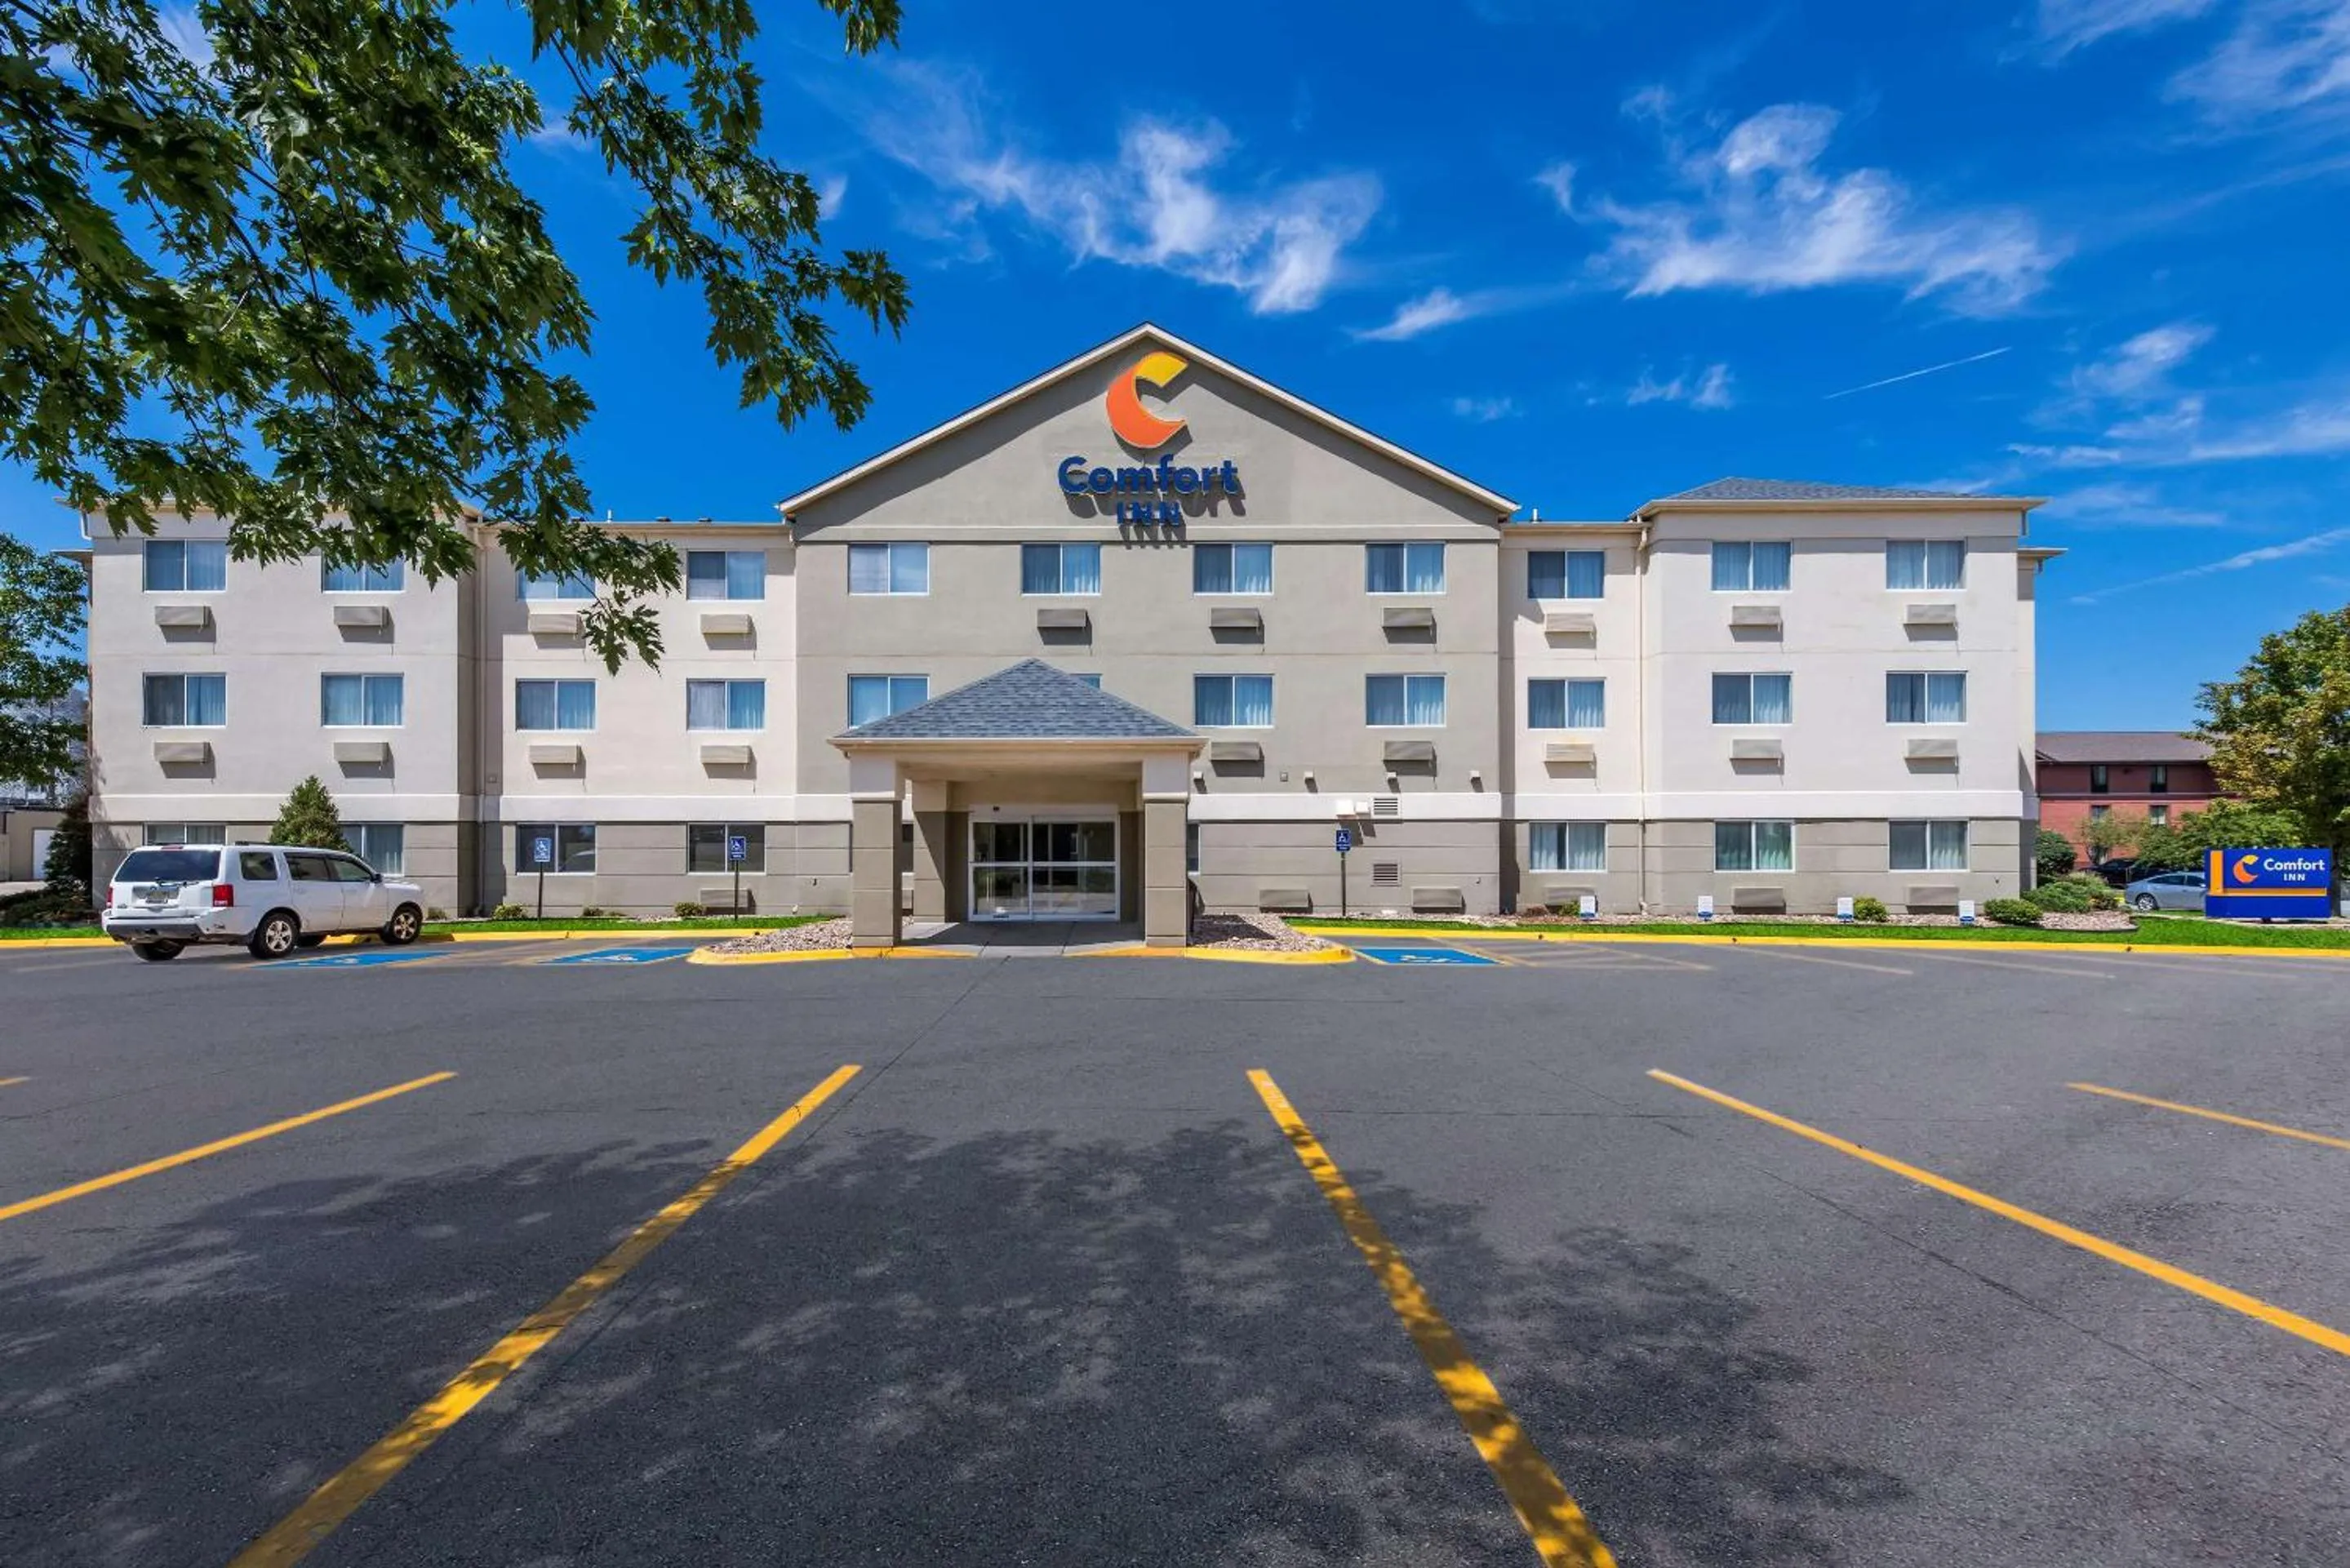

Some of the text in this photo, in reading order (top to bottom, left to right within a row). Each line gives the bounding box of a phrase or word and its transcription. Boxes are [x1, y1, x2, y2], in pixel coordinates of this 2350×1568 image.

[1058, 454, 1239, 494] Comfort
[1117, 500, 1180, 525] INN
[2263, 858, 2325, 871] Comfort
[2283, 873, 2306, 882] INN
